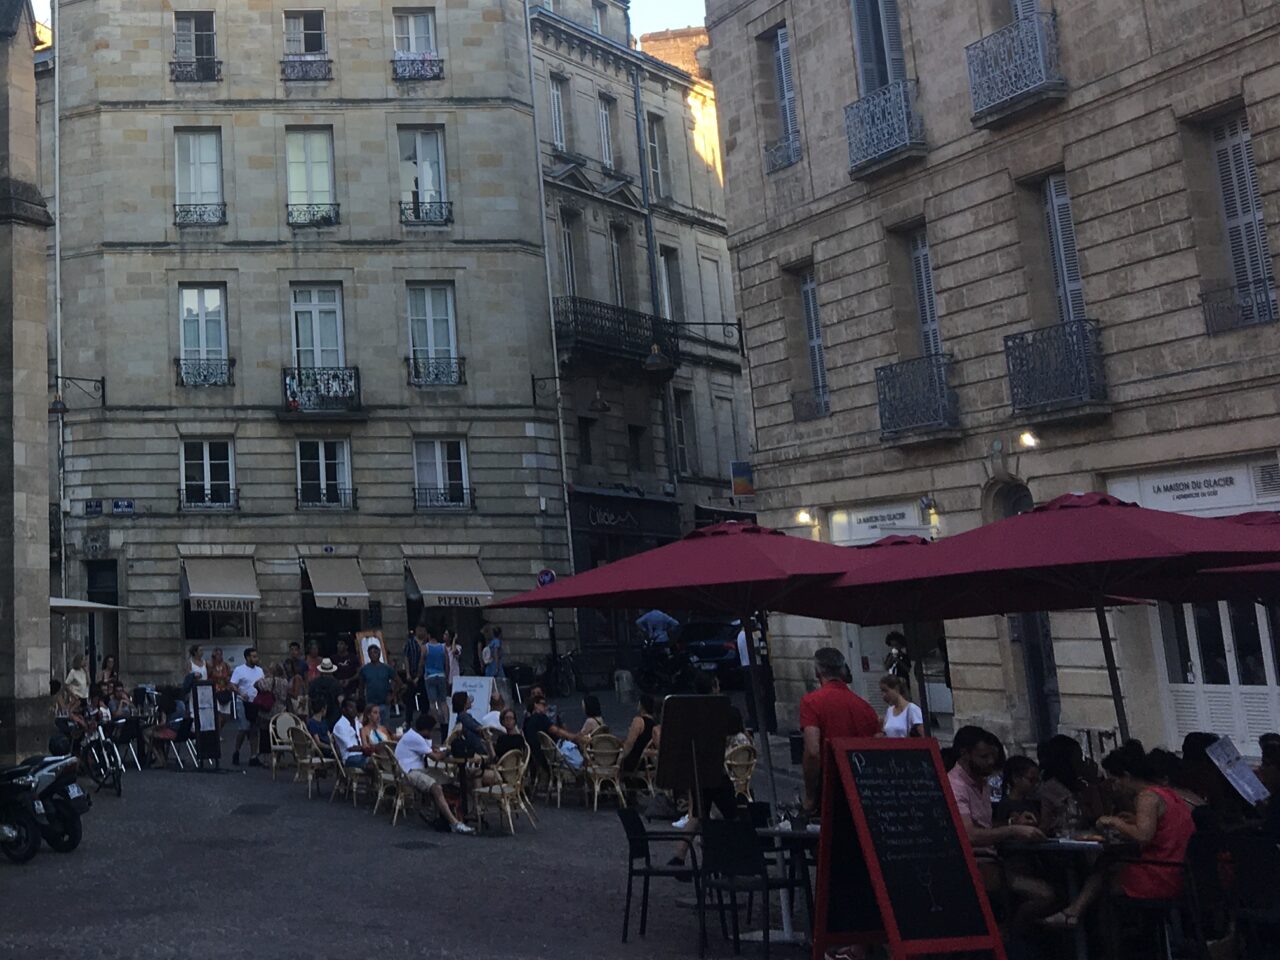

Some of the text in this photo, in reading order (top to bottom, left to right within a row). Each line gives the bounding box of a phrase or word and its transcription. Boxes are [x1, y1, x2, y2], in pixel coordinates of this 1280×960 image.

[1152, 476, 1234, 494] LA MAISON DU GLACIER
[196, 599, 254, 611] RESTAURANT
[336, 597, 348, 607] AZ
[437, 596, 481, 606] PIZZERIA
